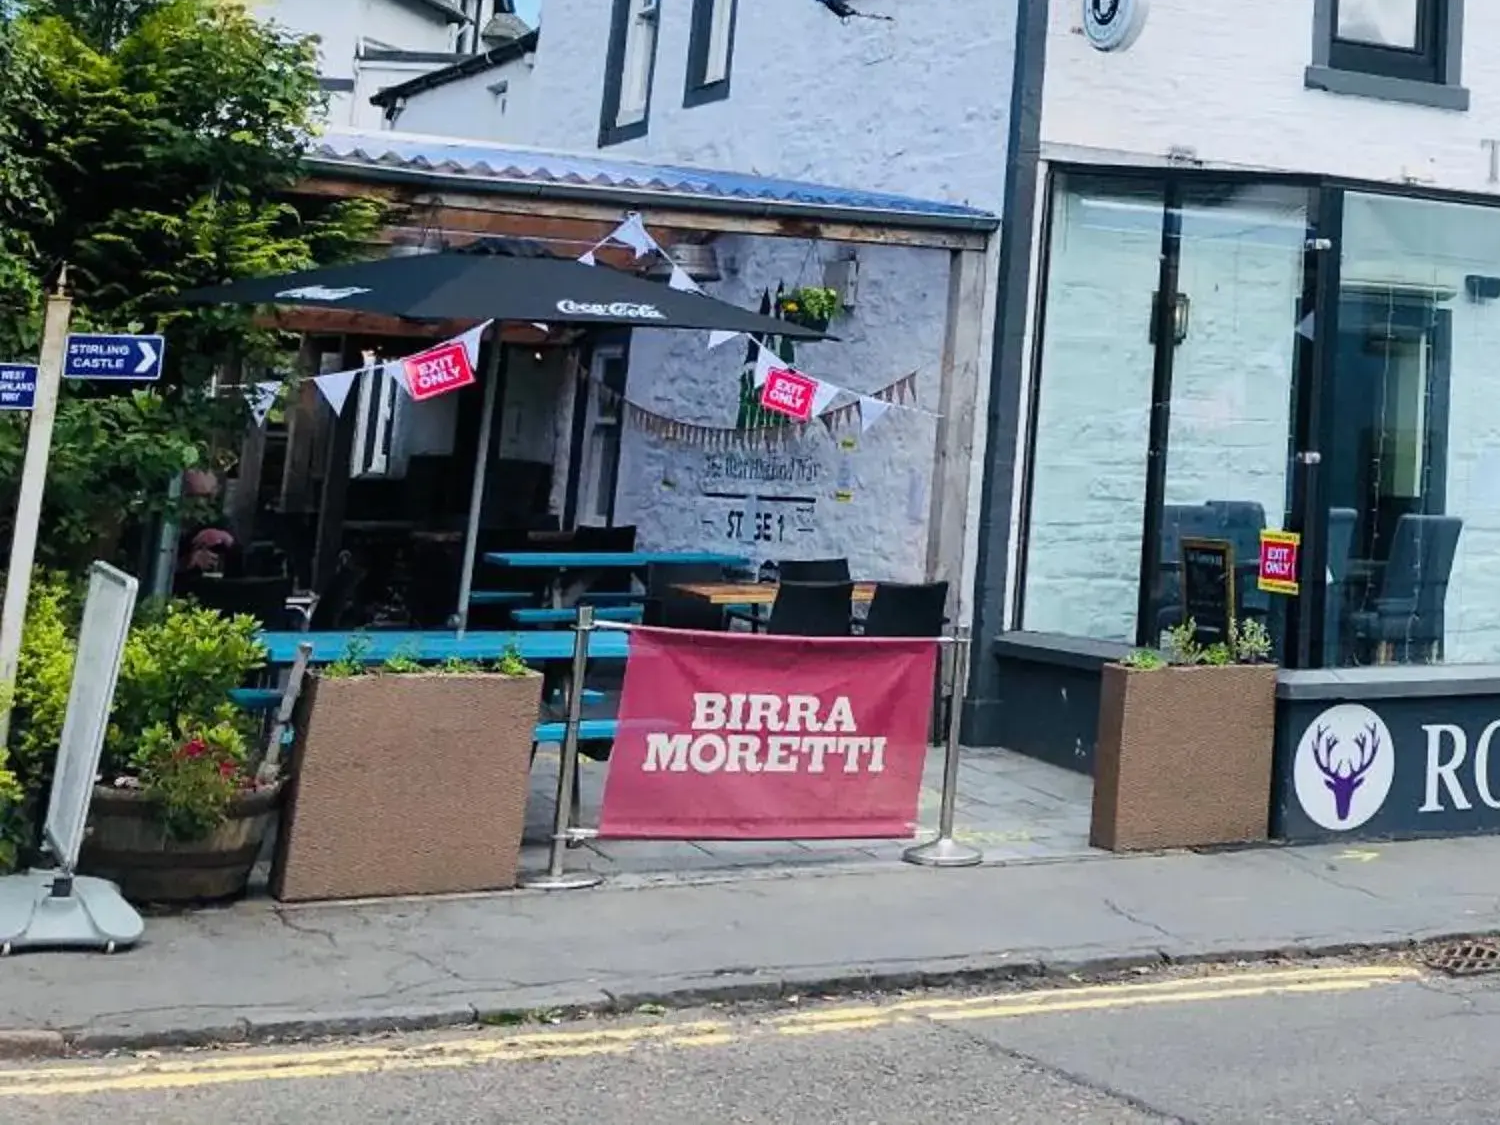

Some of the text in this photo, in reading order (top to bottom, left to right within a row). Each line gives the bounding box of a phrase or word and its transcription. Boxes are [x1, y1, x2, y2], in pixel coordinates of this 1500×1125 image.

[69, 343, 130, 356] STIRLING
[72, 357, 125, 369] CASTLE
[416, 354, 455, 376] EXIT
[418, 365, 461, 389] ONLY
[775, 378, 807, 397] EXIT
[768, 390, 805, 409] ONLY
[1267, 547, 1289, 561] EXIT
[1265, 560, 1291, 575] ONLY
[691, 692, 857, 733] BIRRA
[642, 733, 887, 774] MORETTI
